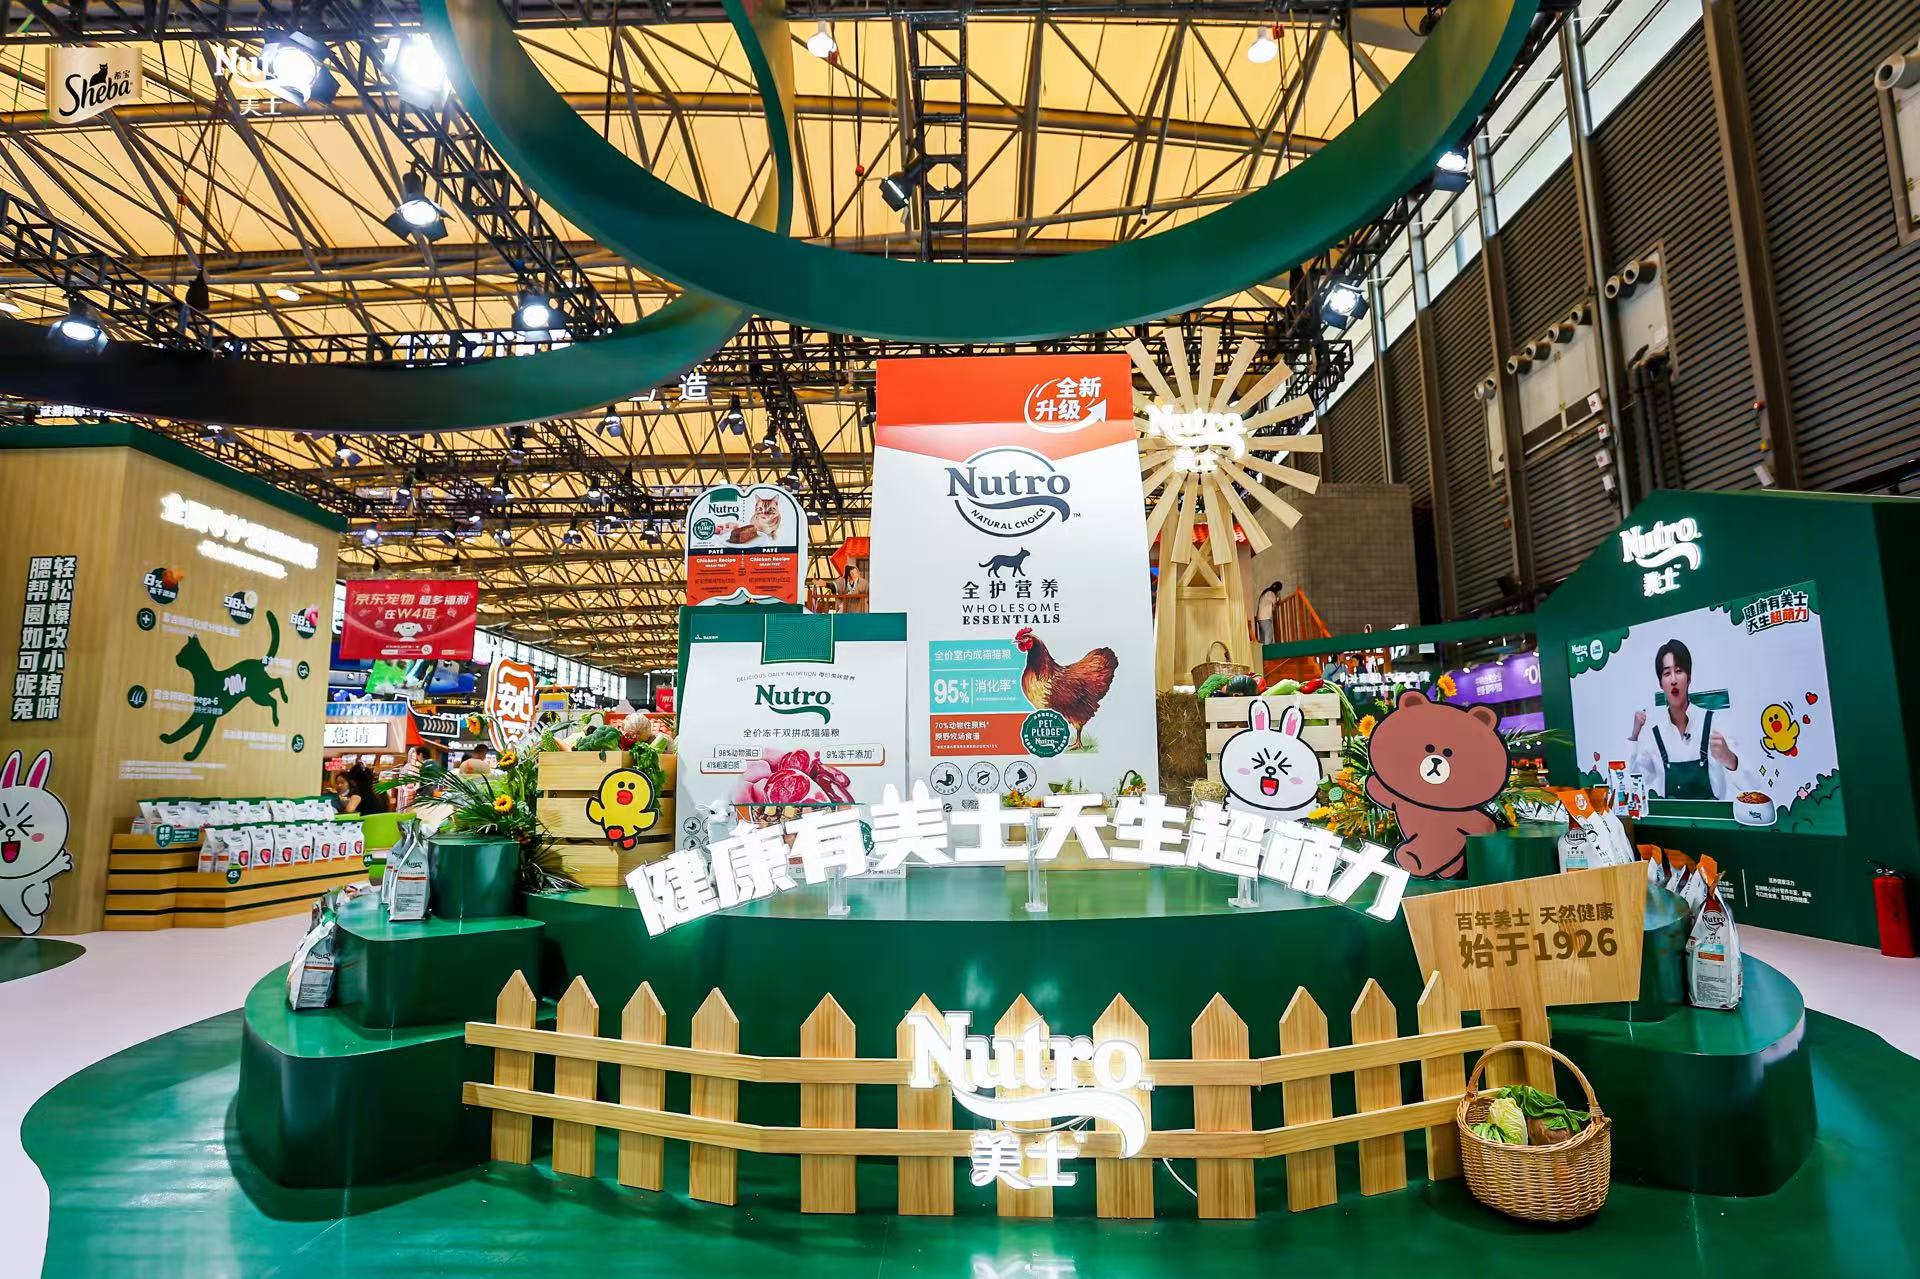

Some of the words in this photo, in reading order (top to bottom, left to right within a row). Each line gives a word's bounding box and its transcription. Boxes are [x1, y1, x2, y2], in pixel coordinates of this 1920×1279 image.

[59, 73, 131, 117] Sheba
[240, 97, 283, 116] 美士
[1056, 376, 1102, 398] 全新
[1035, 399, 1081, 421] 升级
[944, 466, 1071, 498] Nutro
[708, 504, 739, 514] Nutro
[971, 508, 1013, 529] NATURAL
[1015, 507, 1047, 529] CHOICE
[1620, 517, 1699, 562] Nutro
[962, 579, 1058, 599] 全护营养
[1643, 566, 1681, 597] 美士
[354, 593, 415, 605] 京东宠物
[962, 603, 1060, 613] WHOLESOME
[1744, 590, 1808, 620] 健康有美士
[384, 608, 437, 620] 在W4馆
[962, 614, 1061, 625] ESSENTIALS
[1747, 607, 1809, 634] 天生超萌力
[12, 557, 52, 720] 腮帮圆如可妮兔
[36, 556, 76, 719] 轻松爆改小猪咪
[935, 649, 1011, 661] 全价室内成猫猫粮
[755, 684, 831, 706] Nutro
[743, 728, 840, 738] 全价冻干双拼成猫猫粮
[1032, 728, 1061, 737] PLEDGE
[1039, 719, 1053, 728] PET
[624, 778, 1411, 937] 健康有美士天生超萌力
[1456, 908, 1530, 930] 百年美士
[1540, 902, 1615, 925] 天然健康
[1702, 915, 1725, 923] Nutro
[1459, 928, 1617, 969] 始于1926
[906, 1010, 1147, 1092] Nutro
[970, 1134, 1077, 1190] 美士
